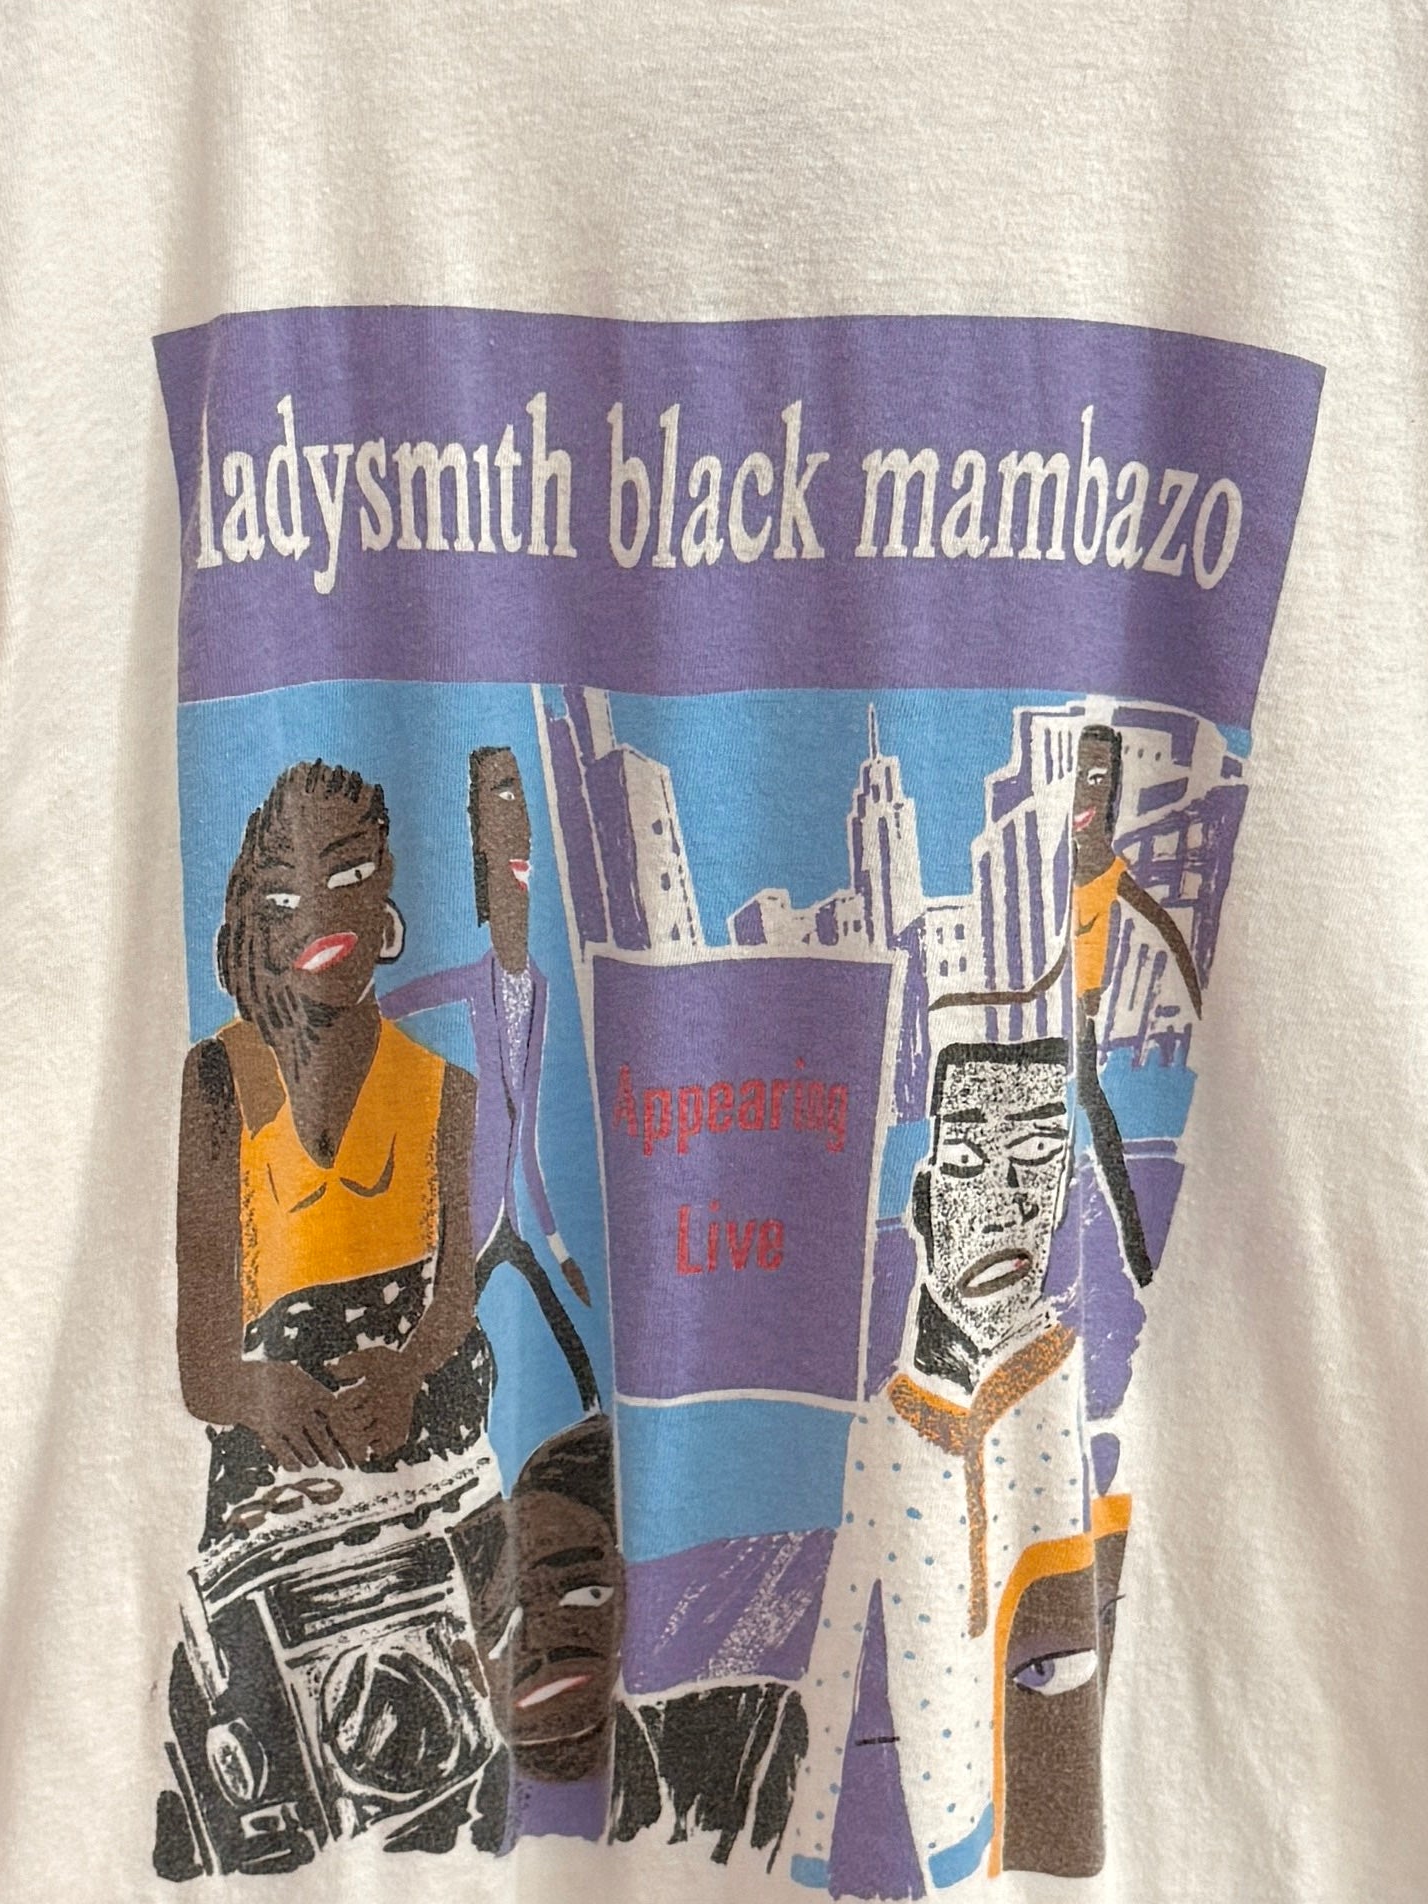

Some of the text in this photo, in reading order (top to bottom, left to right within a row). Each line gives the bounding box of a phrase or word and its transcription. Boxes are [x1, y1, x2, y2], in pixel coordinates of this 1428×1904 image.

[196, 391, 1243, 595] ladysmith black mambazo
[612, 1056, 849, 1158] Appearing
[675, 1199, 785, 1277] Live
